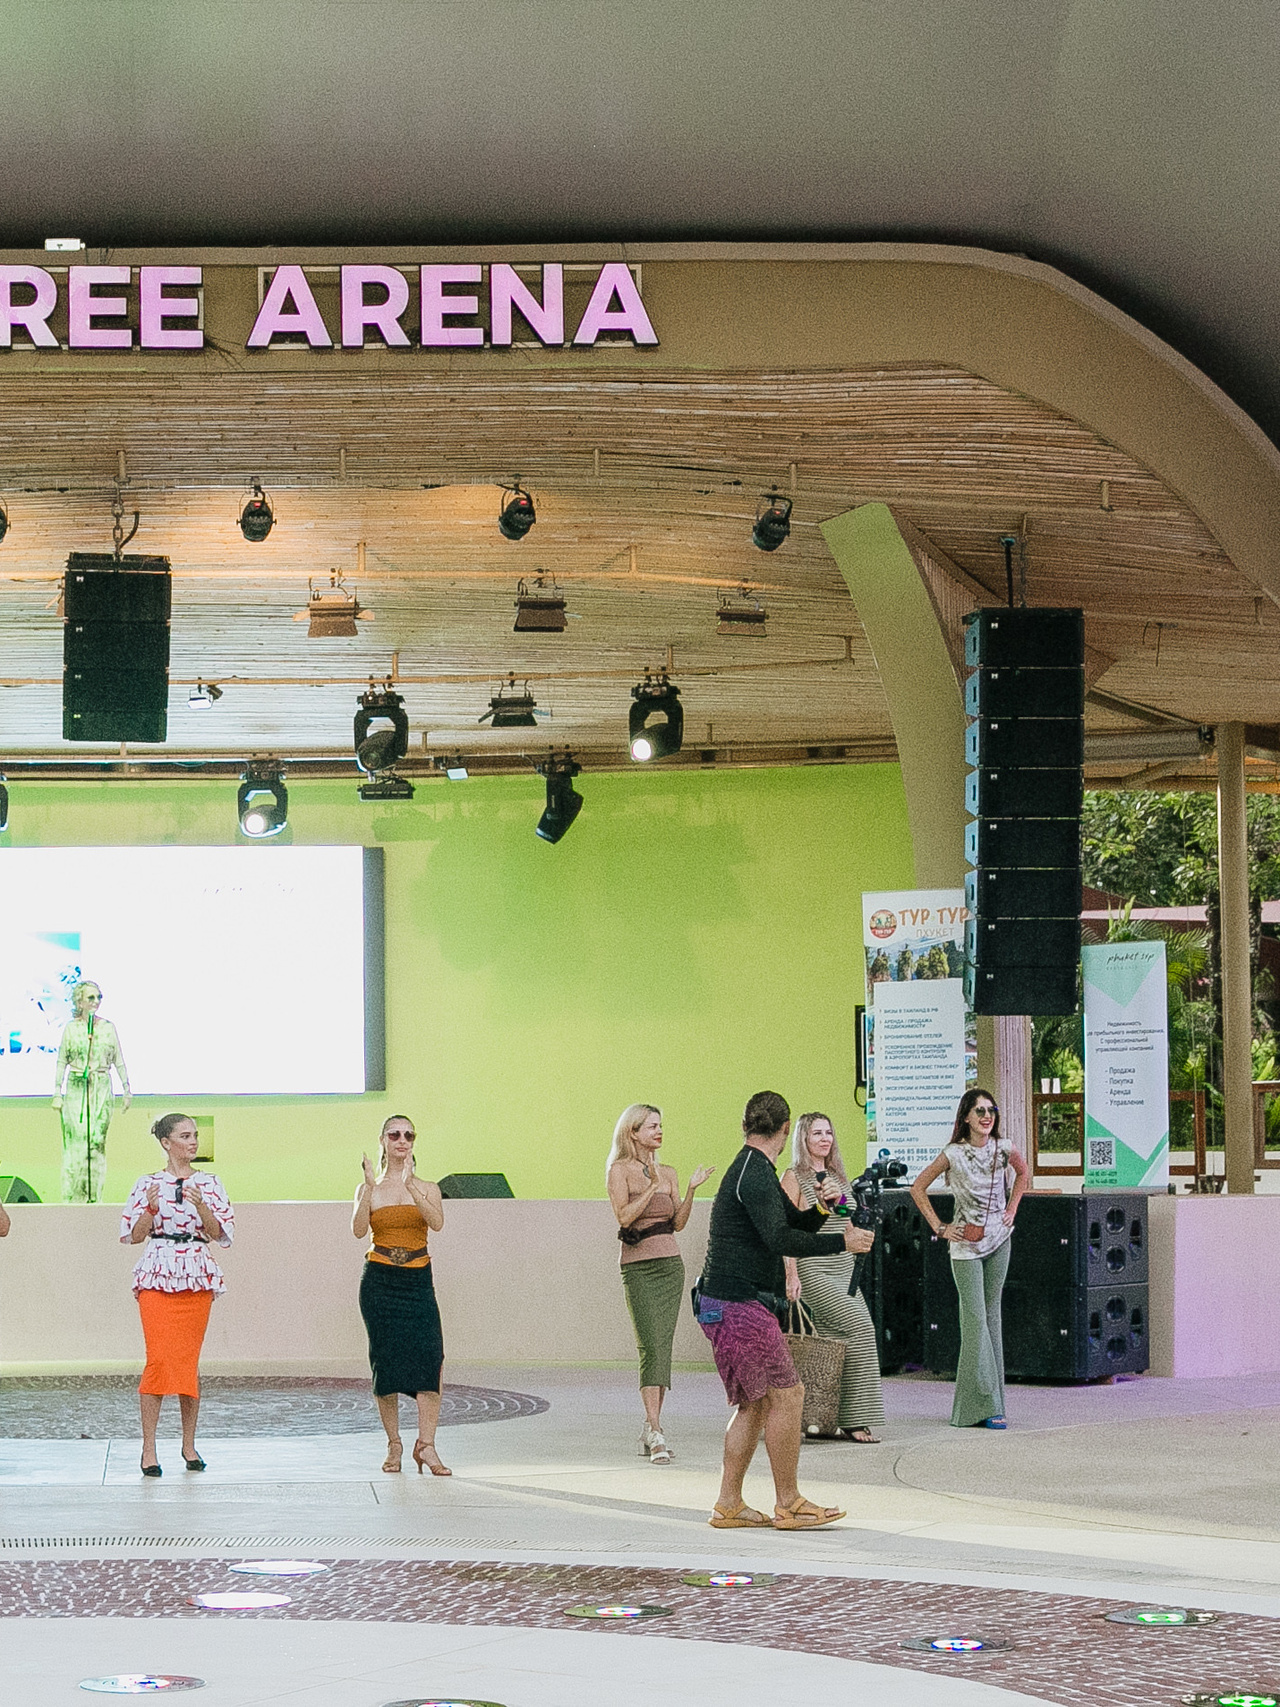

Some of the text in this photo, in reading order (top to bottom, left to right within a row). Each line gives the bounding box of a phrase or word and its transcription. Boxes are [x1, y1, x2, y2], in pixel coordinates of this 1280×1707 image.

[245, 262, 660, 348] ARENA
[898, 906, 970, 926] ТУР ТУР
[916, 928, 954, 938] ПХУКЕТ
[1107, 953, 1139, 964] phuket
[1109, 1078, 1134, 1086] Покупка
